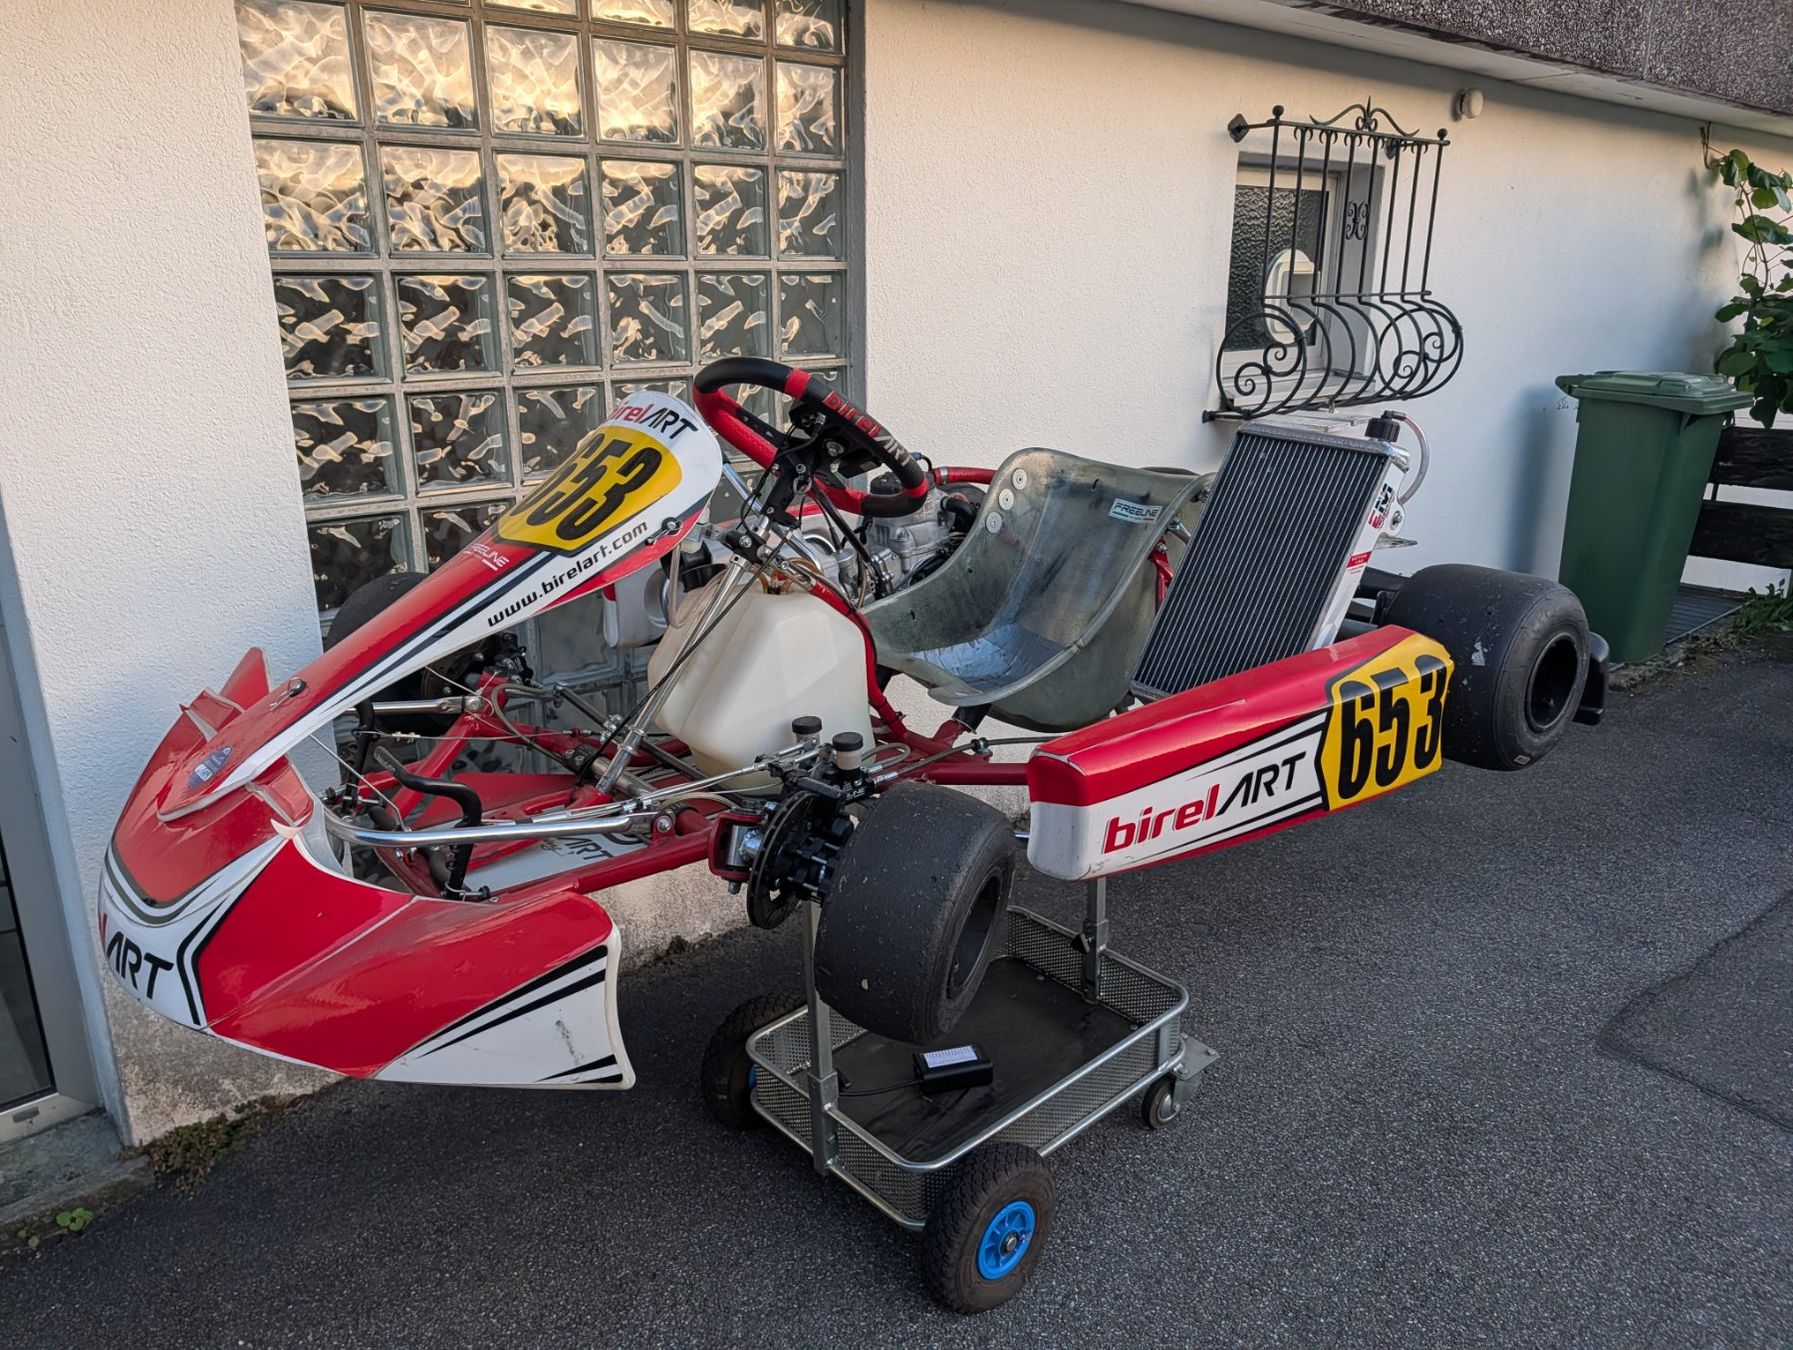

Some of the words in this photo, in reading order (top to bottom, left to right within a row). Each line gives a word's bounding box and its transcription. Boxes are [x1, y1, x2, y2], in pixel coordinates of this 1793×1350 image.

[509, 432, 662, 541] 653
[1114, 502, 1159, 517] FREELINE
[488, 521, 648, 627] www.birelart.com
[1338, 654, 1447, 799] 653
[1102, 751, 1306, 855] birelART
